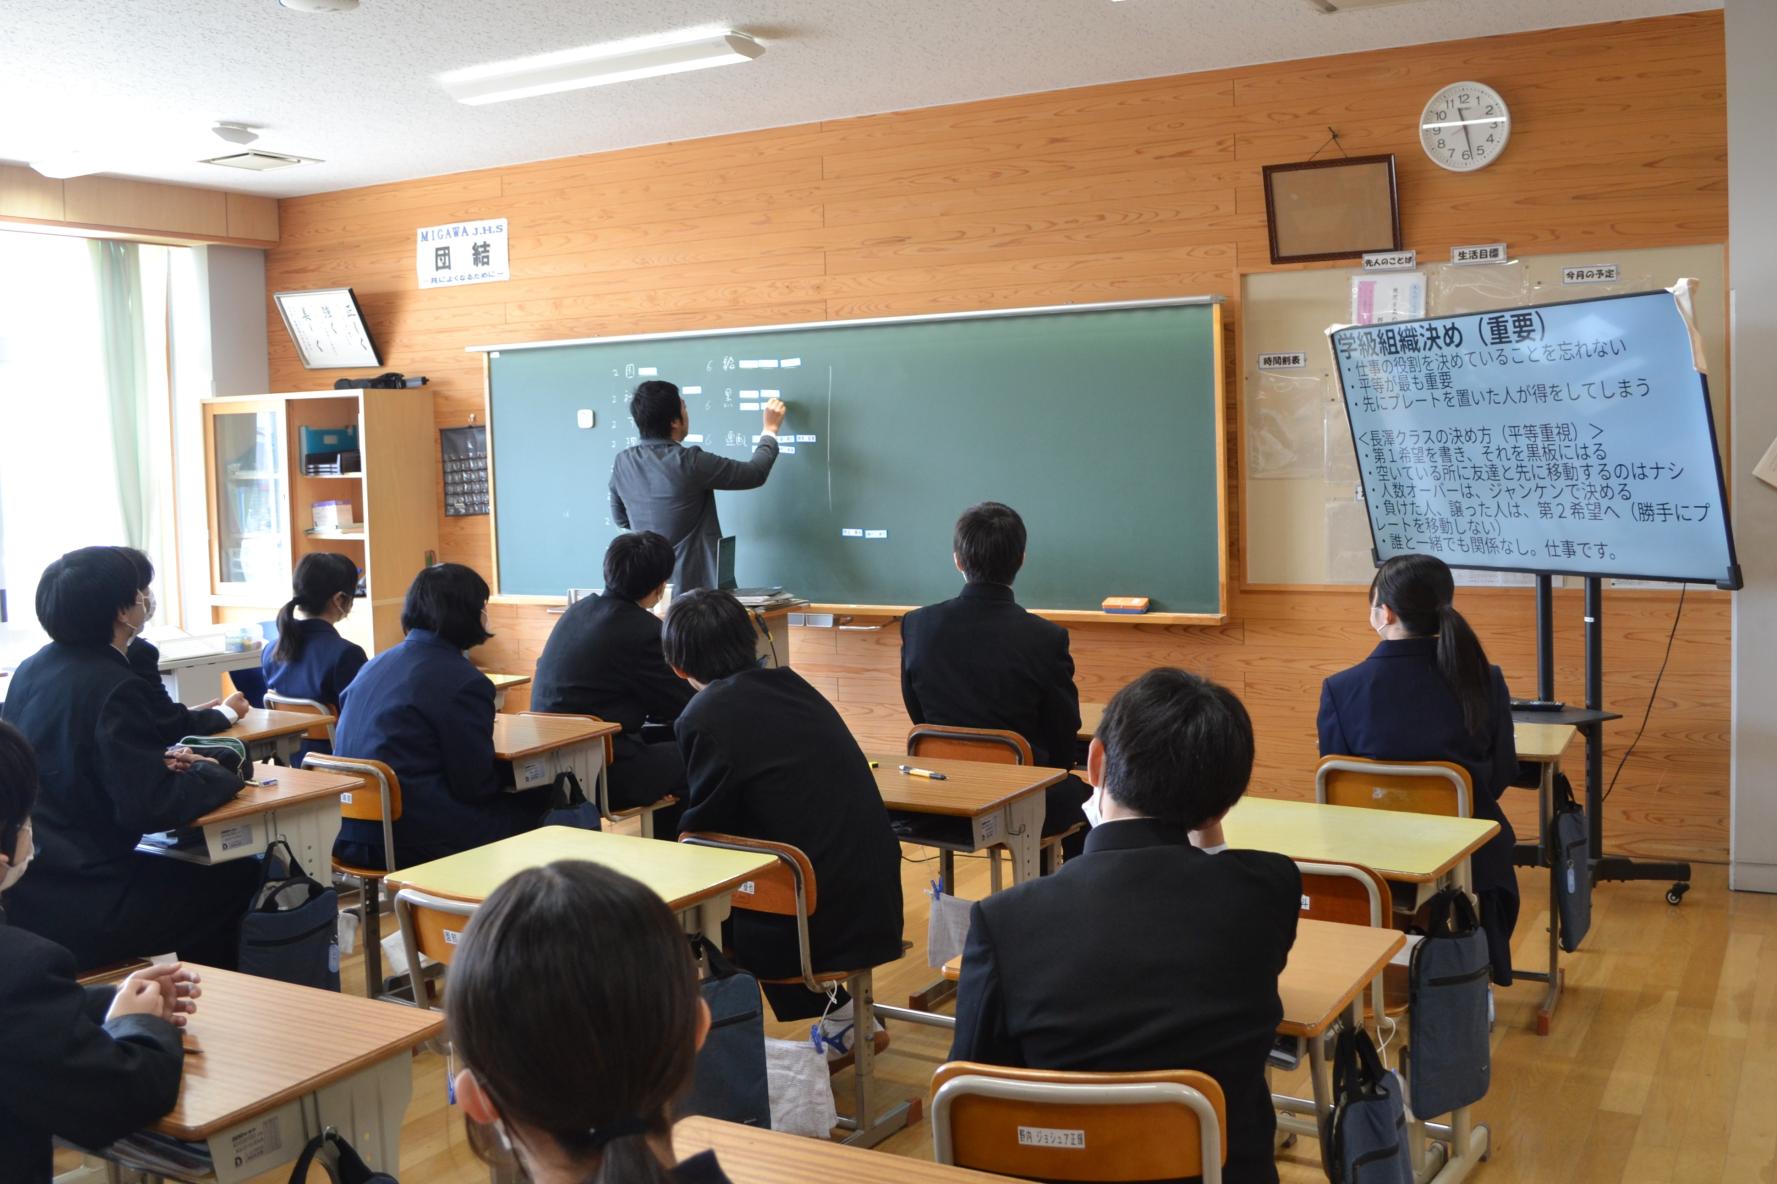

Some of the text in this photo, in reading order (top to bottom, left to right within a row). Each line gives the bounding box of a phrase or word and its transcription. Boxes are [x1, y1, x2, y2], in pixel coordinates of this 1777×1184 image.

[1445, 98, 1454, 110] 11
[1458, 93, 1470, 104] 12
[1475, 95, 1481, 105] 1
[1435, 110, 1447, 120] 10
[1485, 104, 1494, 115] 2
[1437, 138, 1446, 149] 8
[1486, 133, 1494, 144] 4
[1447, 148, 1456, 159] 7
[1461, 150, 1471, 160] 6
[1476, 145, 1485, 156] 5
[420, 225, 469, 242] MIGAWA
[1458, 247, 1500, 261] 生活目標
[1364, 255, 1413, 267] 先人のことば
[1565, 268, 1616, 280] 今月の予定
[1263, 356, 1300, 366] 時間割表
